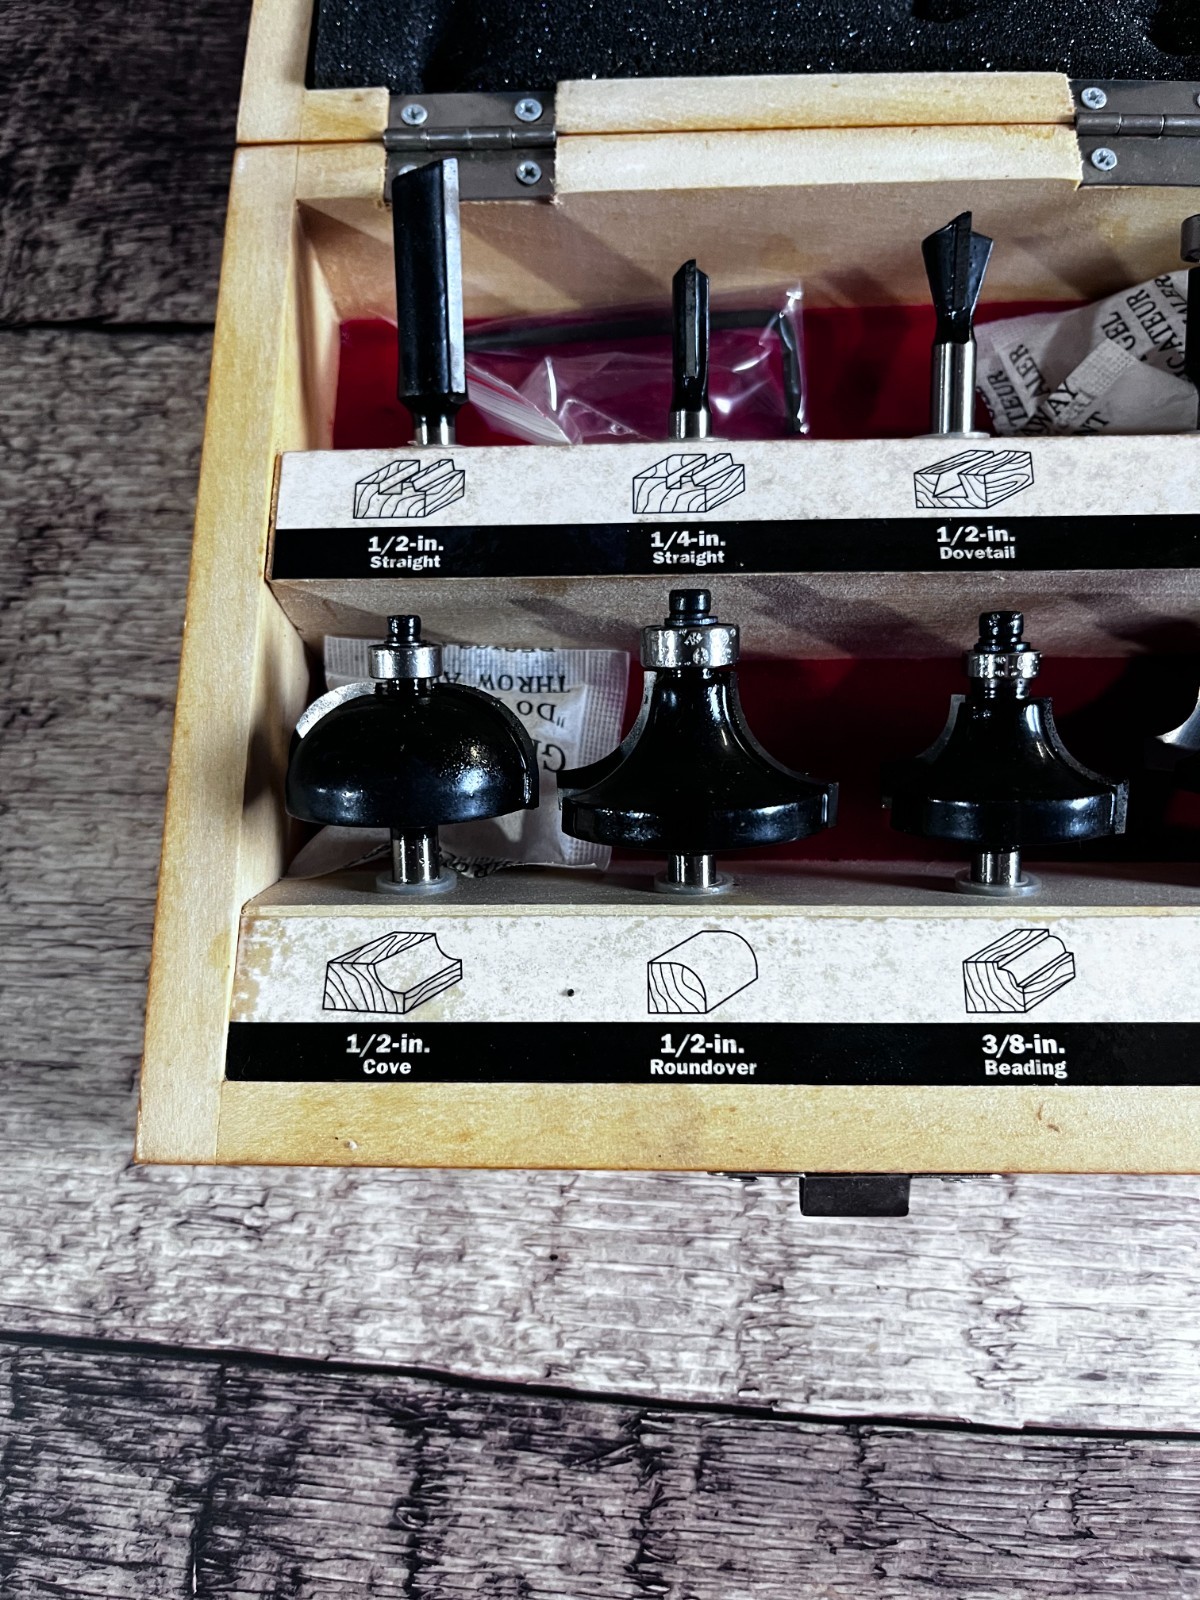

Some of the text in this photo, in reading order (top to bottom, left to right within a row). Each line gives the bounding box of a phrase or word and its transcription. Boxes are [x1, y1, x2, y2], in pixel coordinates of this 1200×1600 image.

[1101, 311, 1137, 351] GEL
[651, 531, 725, 549] 1/4-in.
[937, 526, 1015, 545] 1/2-in.
[368, 536, 443, 555] 1/2-in.
[940, 546, 1015, 559] Dovetail
[370, 556, 440, 570] Straight
[653, 551, 724, 566] Straight
[479, 674, 570, 693] THROW
[347, 1034, 430, 1057] 1/2-in.
[661, 1034, 744, 1057] 1/2-in.
[982, 1034, 1065, 1057] 3/8-in.
[363, 1059, 411, 1074] Cove
[651, 1059, 757, 1075] Roundover
[985, 1060, 1067, 1079] Beading
